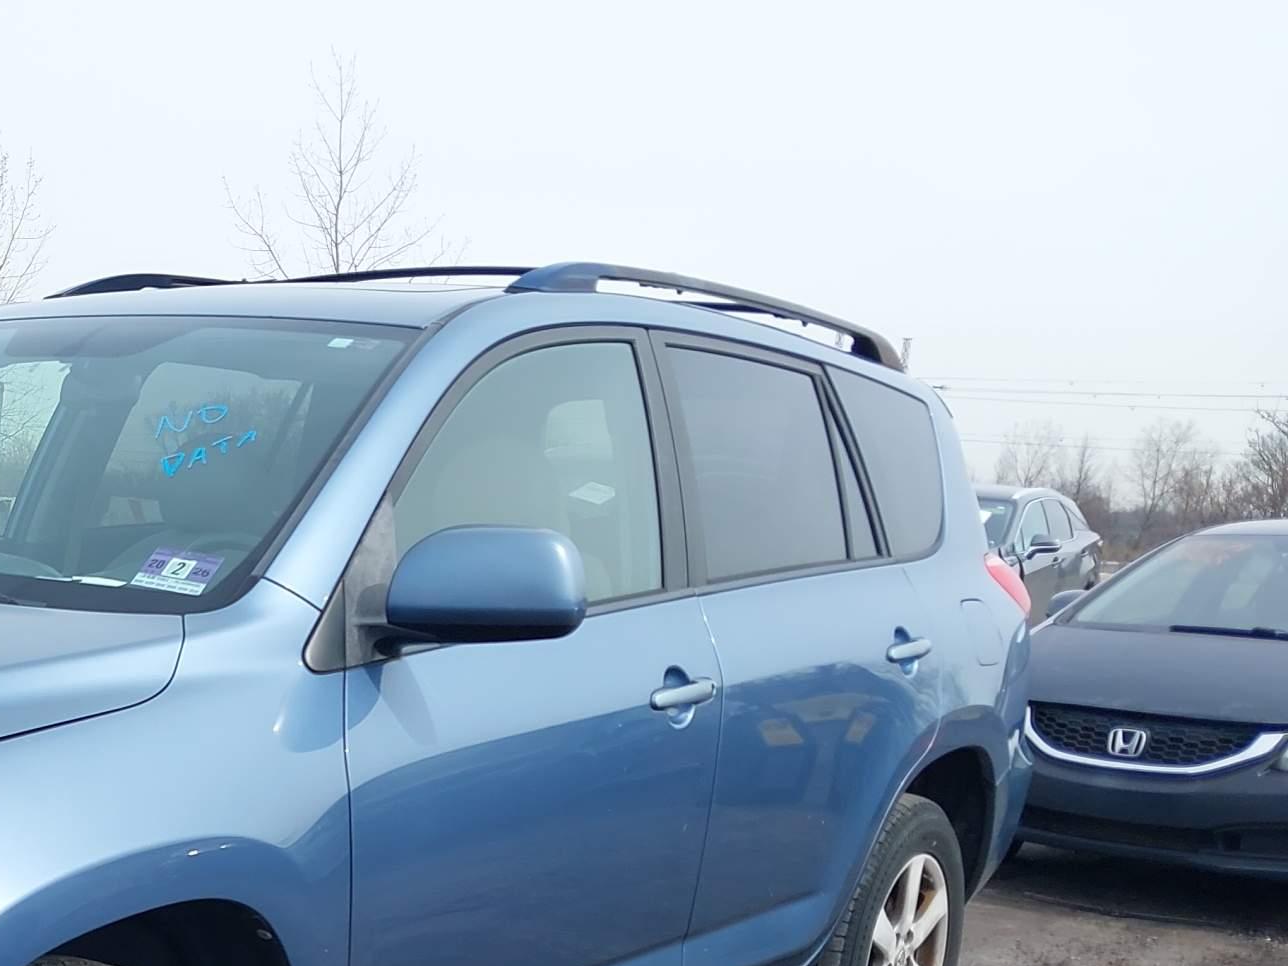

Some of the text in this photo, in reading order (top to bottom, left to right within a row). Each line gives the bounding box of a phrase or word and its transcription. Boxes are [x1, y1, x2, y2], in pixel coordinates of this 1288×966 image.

[154, 404, 229, 439] NO
[160, 430, 258, 477] DATA
[148, 558, 210, 578] 20 2 26
